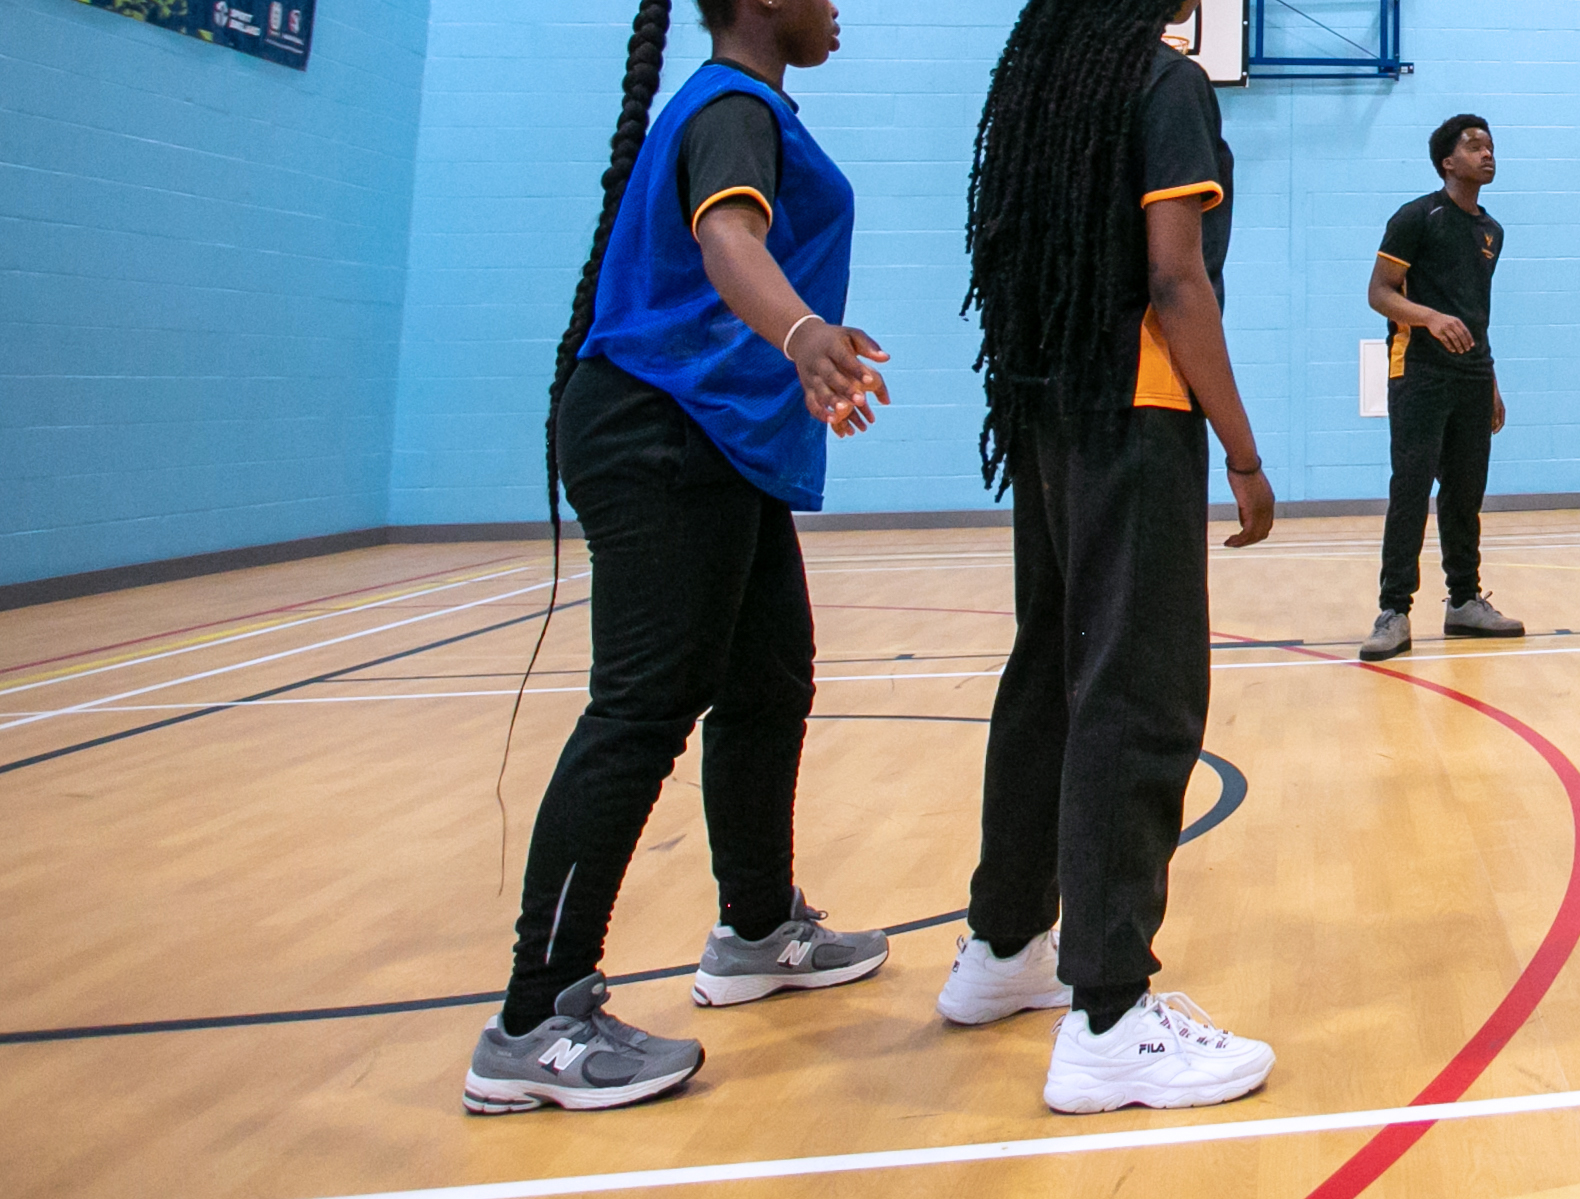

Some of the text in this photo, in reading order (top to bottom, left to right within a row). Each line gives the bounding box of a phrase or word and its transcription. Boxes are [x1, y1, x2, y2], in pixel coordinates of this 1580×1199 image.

[777, 940, 812, 966] N
[538, 1038, 587, 1071] N
[1138, 1042, 1166, 1055] FILA
